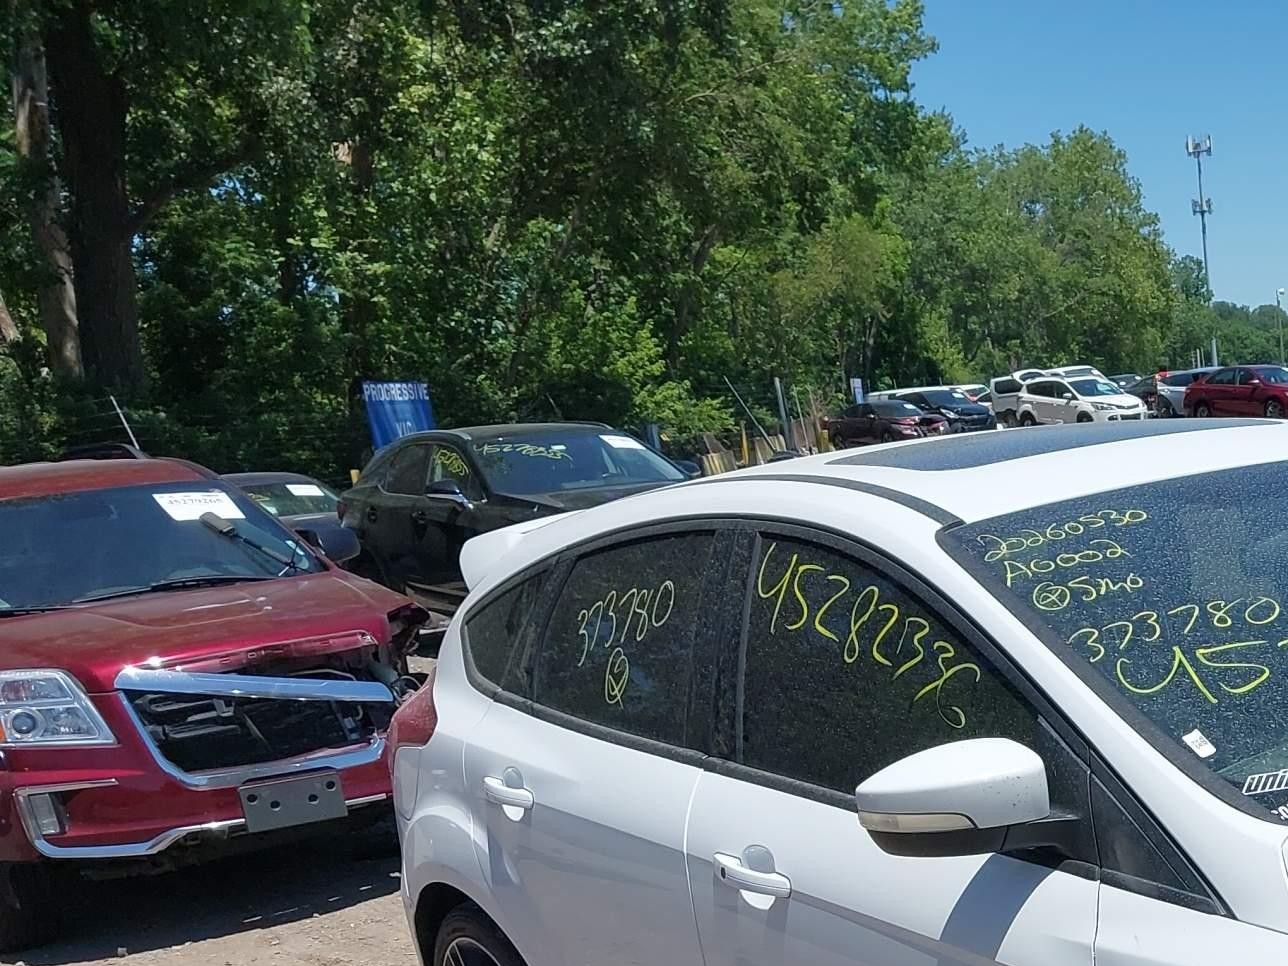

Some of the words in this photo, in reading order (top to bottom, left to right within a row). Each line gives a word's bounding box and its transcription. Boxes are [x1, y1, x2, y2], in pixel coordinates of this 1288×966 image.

[362, 383, 430, 401] PROGRESSIVE
[578, 581, 674, 667] 373780
[758, 542, 980, 728] 45282336
[1067, 596, 1281, 662] 373780
